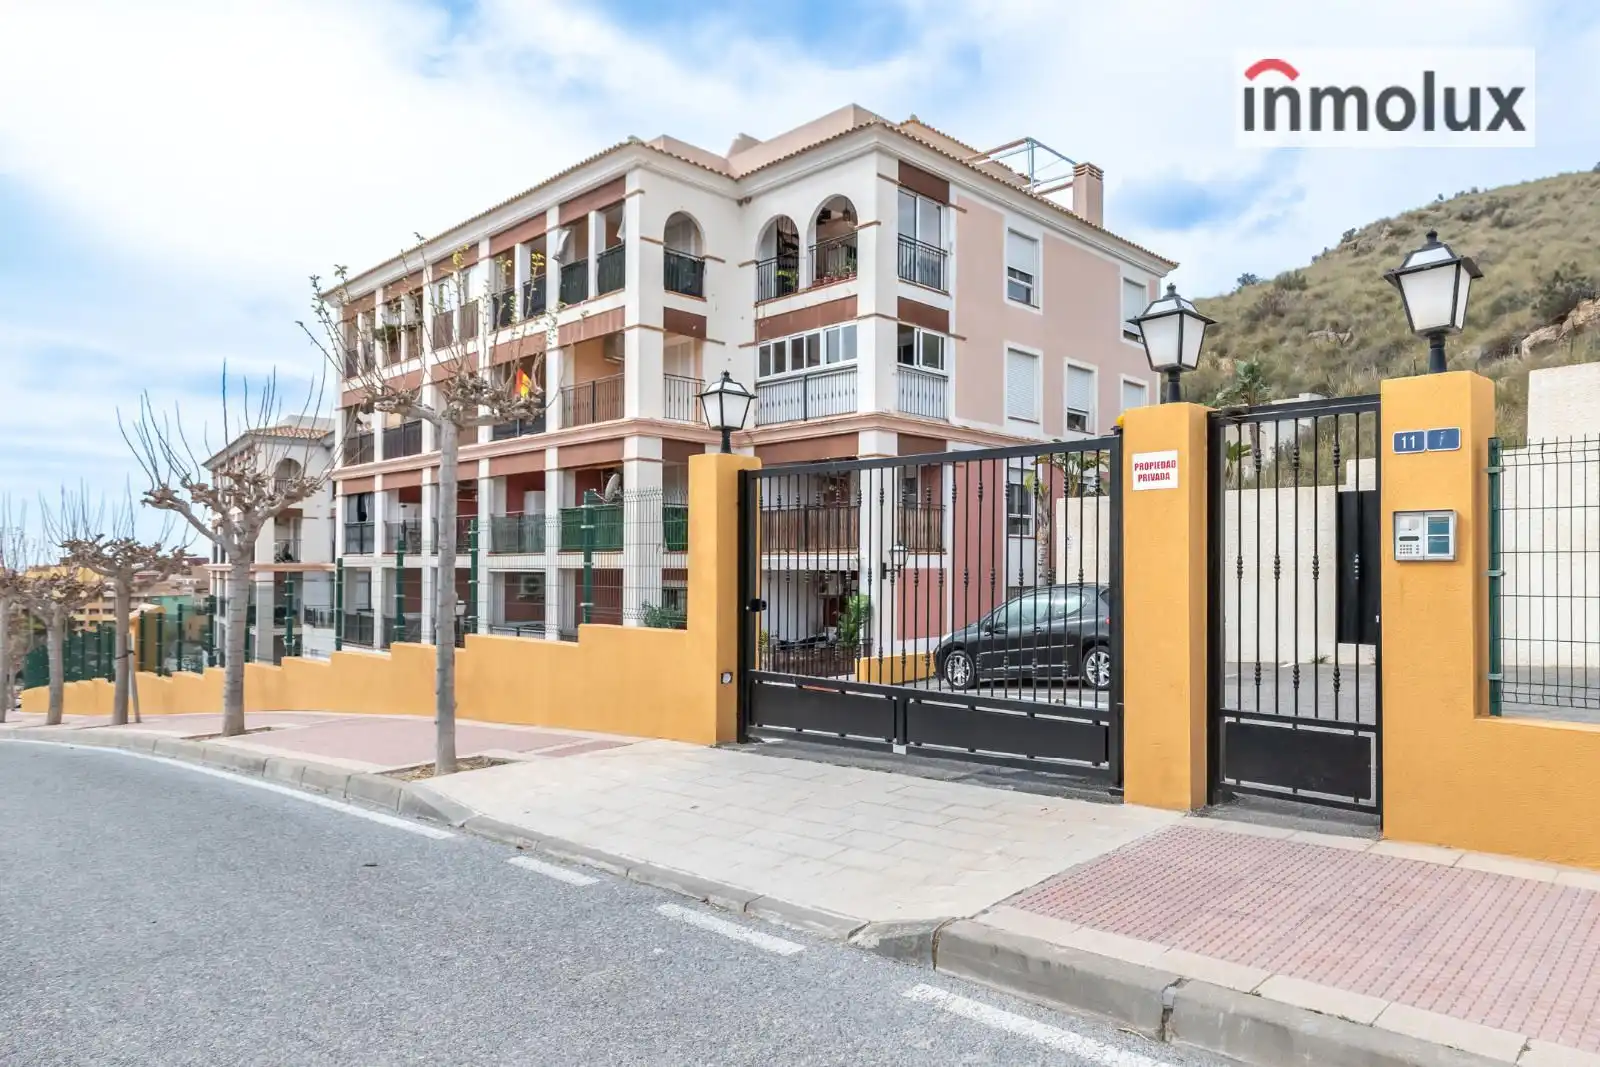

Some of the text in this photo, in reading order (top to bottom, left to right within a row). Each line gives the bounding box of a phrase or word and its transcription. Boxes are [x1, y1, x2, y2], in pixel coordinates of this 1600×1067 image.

[1401, 435, 1416, 449] 11
[1134, 460, 1176, 471] PROPIEDAD
[1137, 472, 1170, 482] PRIVADA
